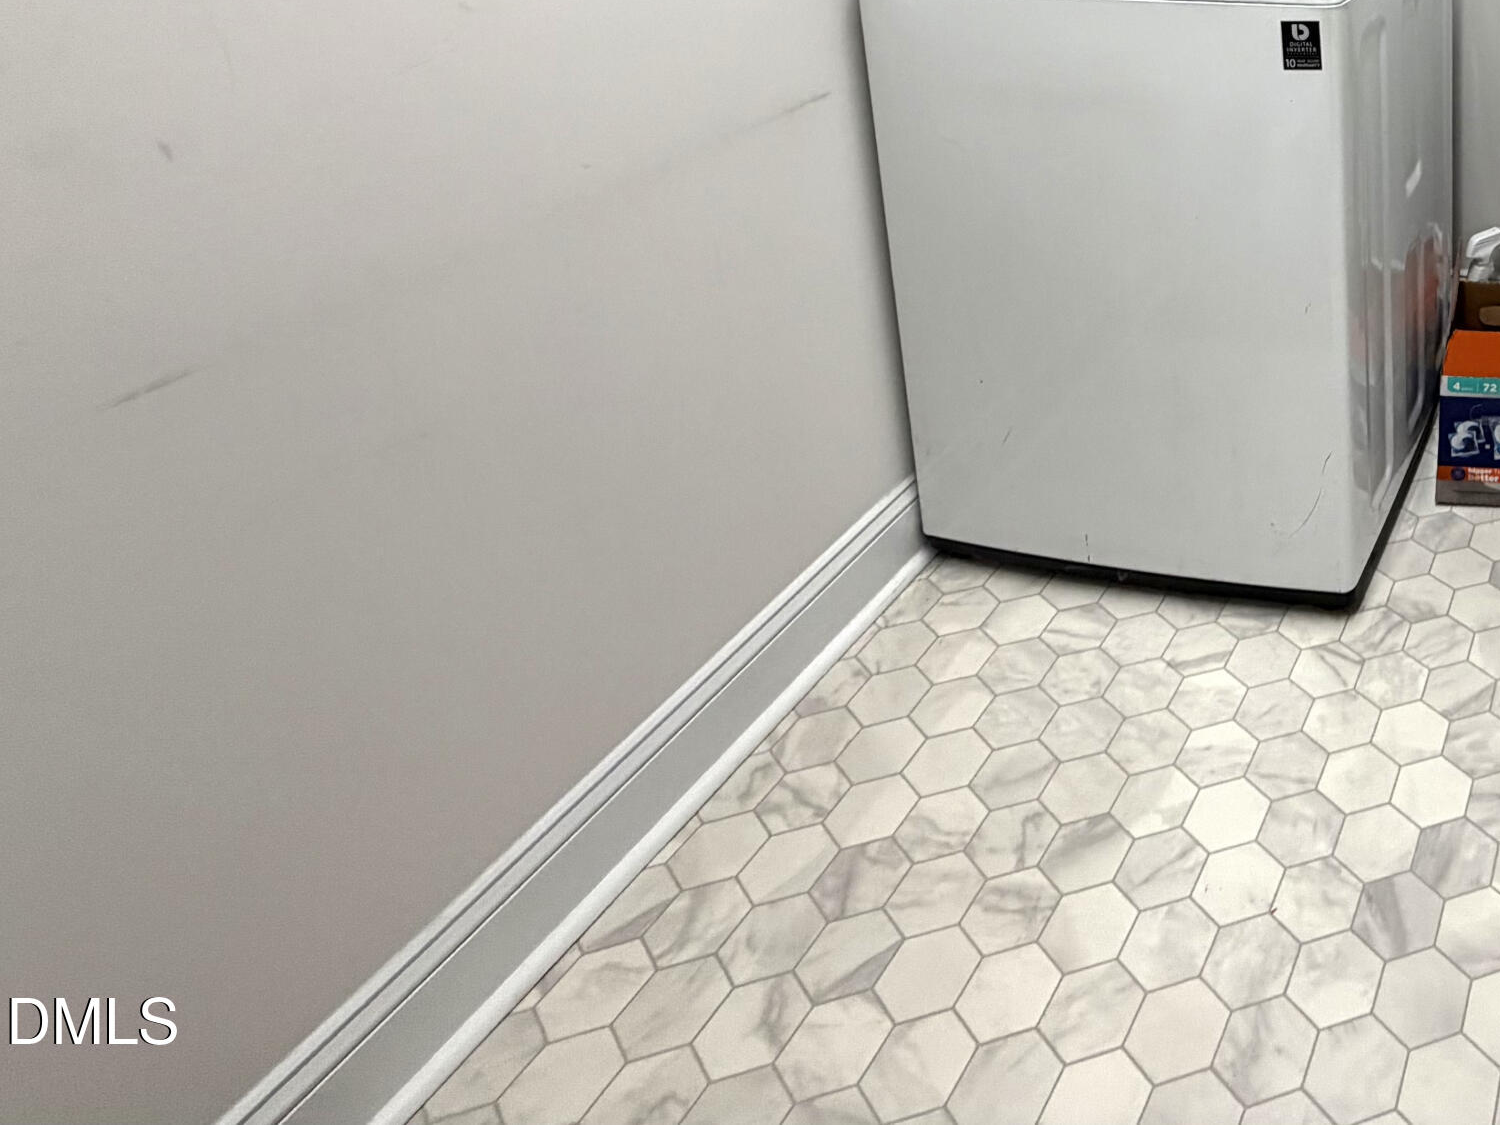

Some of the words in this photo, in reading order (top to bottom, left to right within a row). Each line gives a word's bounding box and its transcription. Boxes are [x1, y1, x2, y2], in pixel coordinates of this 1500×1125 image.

[1285, 59, 1296, 68] 10
[1453, 382, 1460, 390] 4
[1483, 383, 1497, 392] 72
